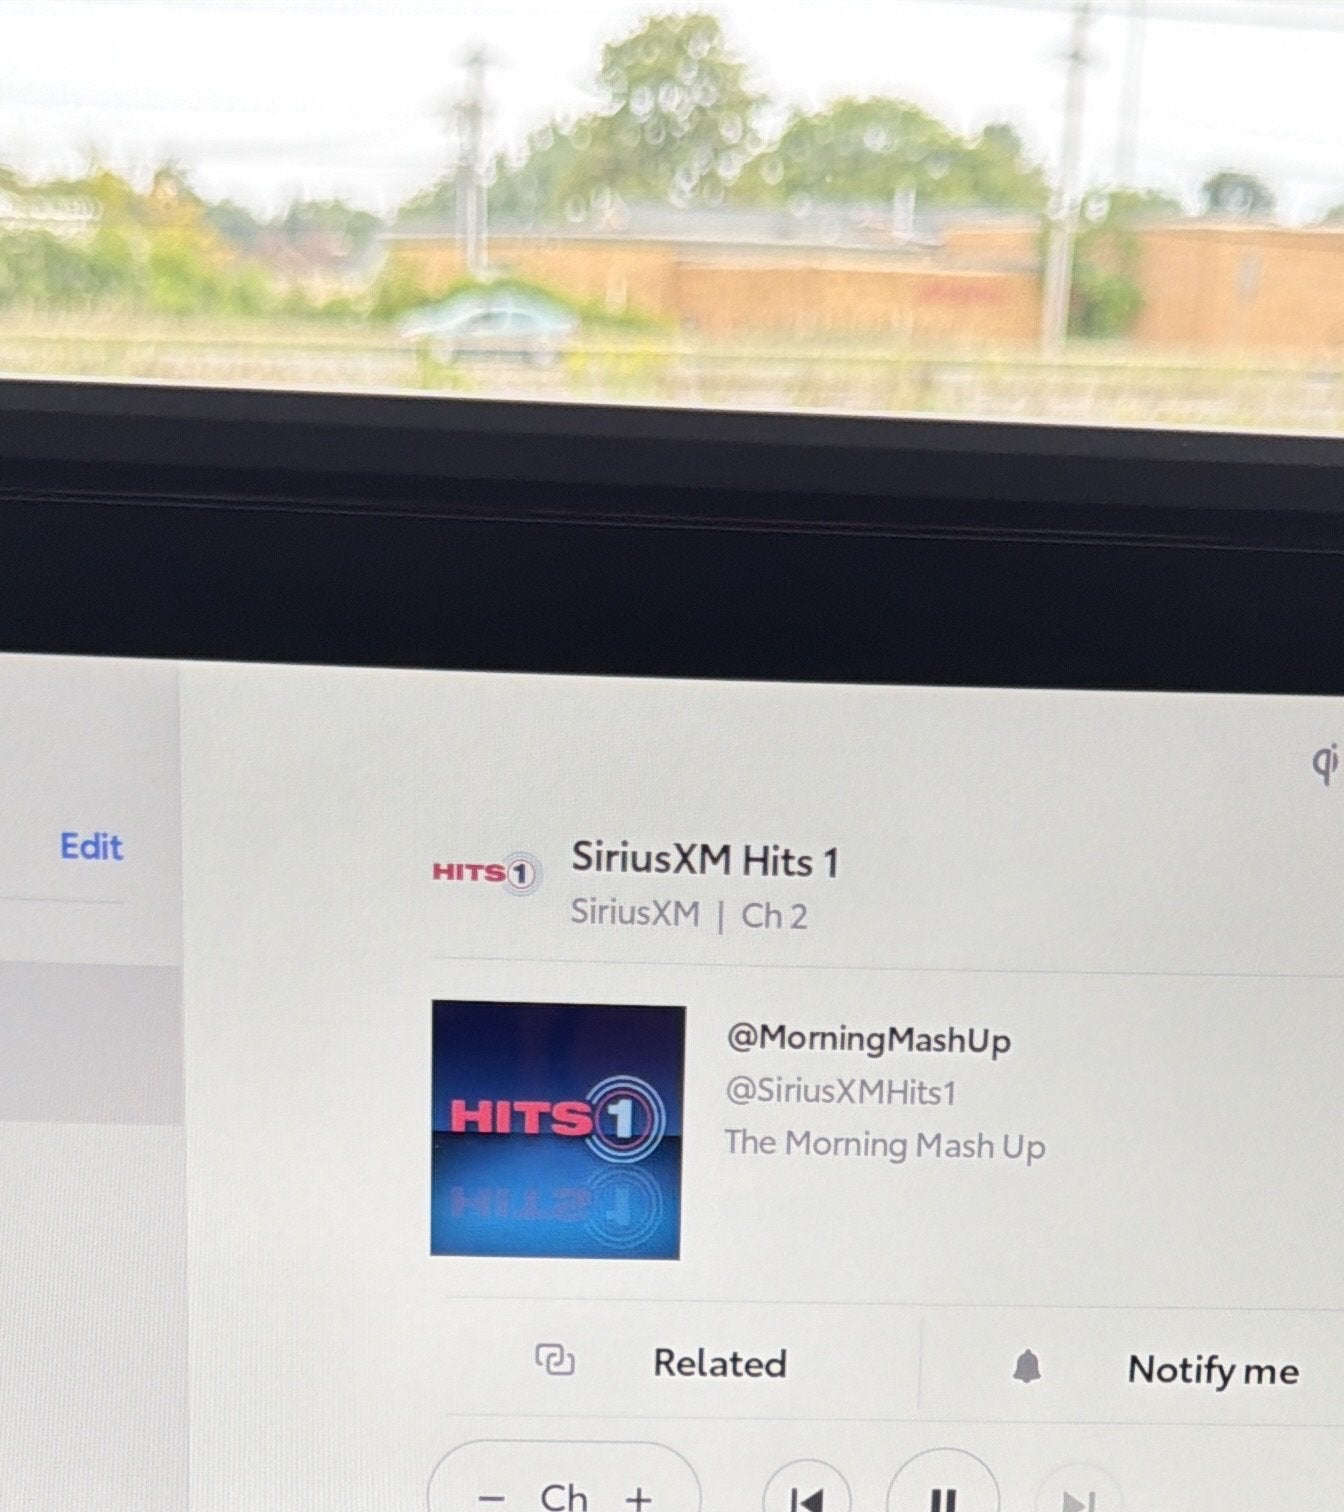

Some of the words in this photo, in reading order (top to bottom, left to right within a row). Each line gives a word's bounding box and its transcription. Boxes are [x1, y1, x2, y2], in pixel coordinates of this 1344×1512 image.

[61, 831, 124, 861] Edit
[572, 839, 731, 876] SiriusXM
[743, 844, 813, 877] Hits
[824, 847, 837, 878] 1
[432, 862, 506, 883] HITS
[571, 896, 700, 927] SiriusXM
[741, 901, 783, 929] Ch
[790, 903, 808, 930] 2
[727, 1022, 1012, 1061] @MorningMashUp
[726, 1075, 955, 1106] @SiriusXMHits1
[449, 1098, 595, 1138] HITS
[605, 1102, 636, 1138] 1
[724, 1127, 777, 1155] The
[785, 1129, 908, 1165] Morning
[916, 1132, 994, 1159] Mash
[1003, 1133, 1046, 1167] Up
[654, 1347, 787, 1378] Related
[1128, 1354, 1237, 1393] Notify
[1244, 1364, 1300, 1385] me
[541, 1482, 588, 1512] Ch
